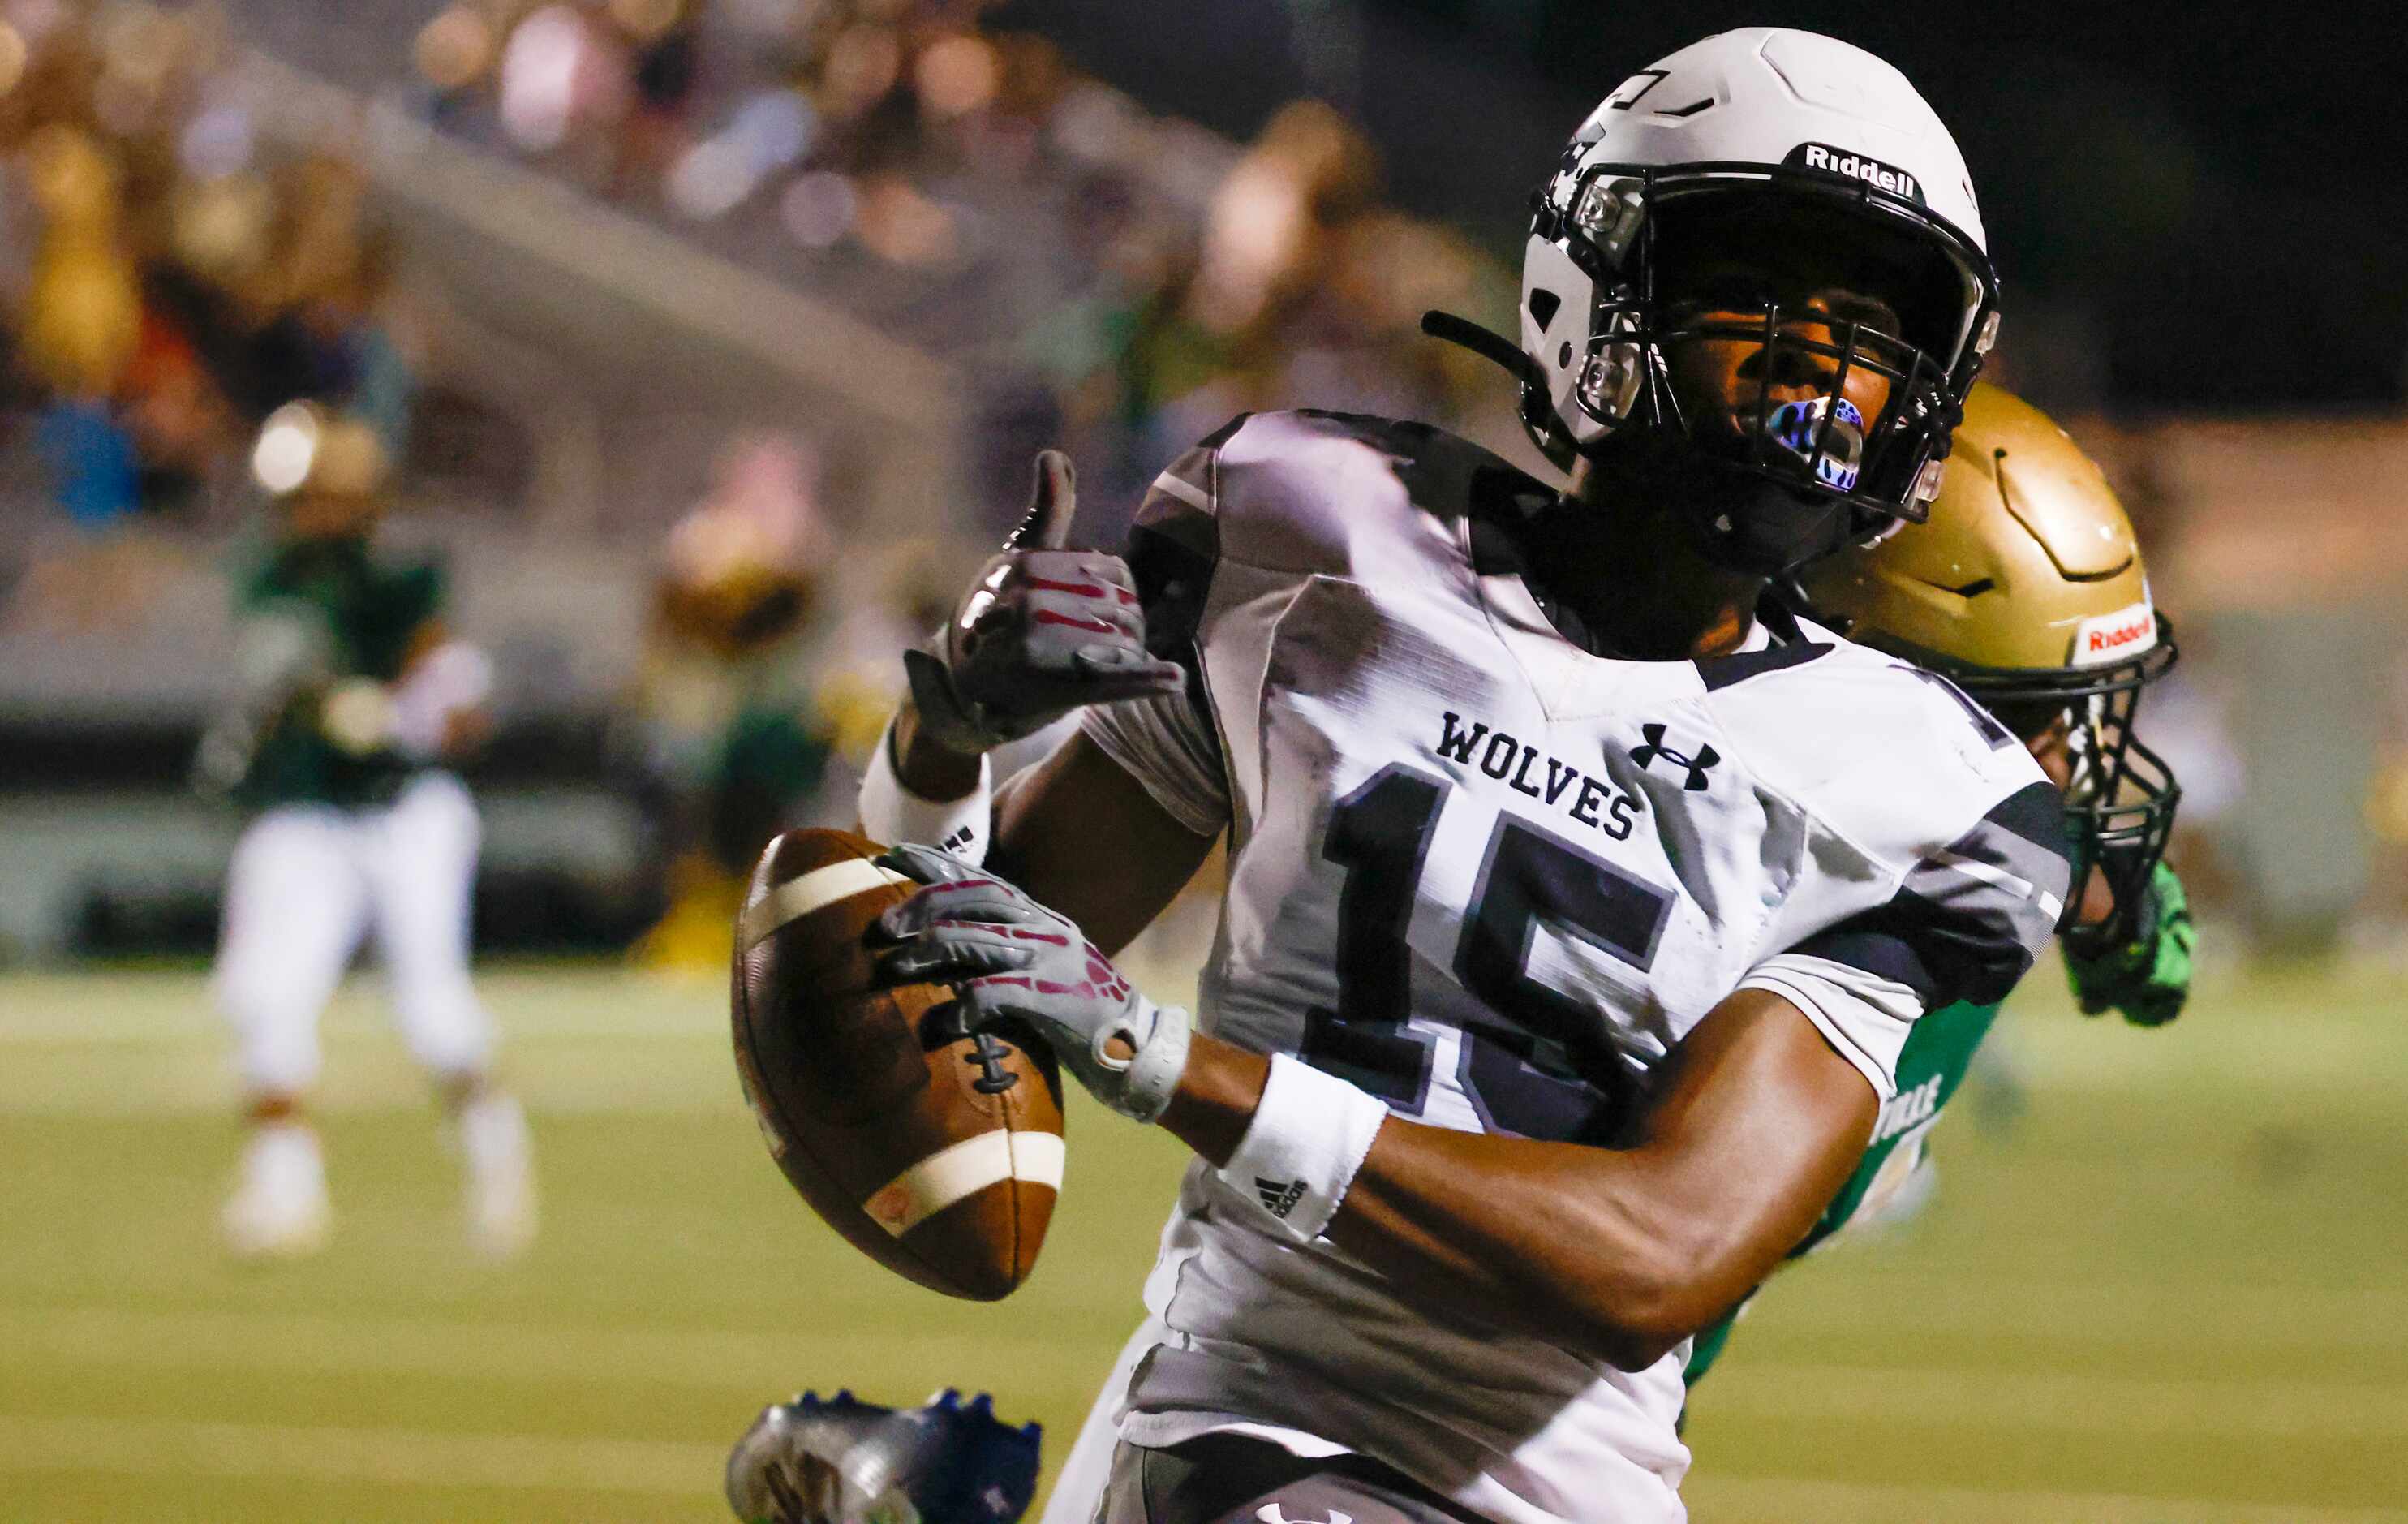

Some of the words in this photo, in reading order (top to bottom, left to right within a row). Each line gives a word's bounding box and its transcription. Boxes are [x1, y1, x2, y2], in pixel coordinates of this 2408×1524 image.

[1805, 144, 1915, 199] Riddell
[1435, 711, 1641, 841] WOLVES
[1301, 761, 1677, 1151] 15
